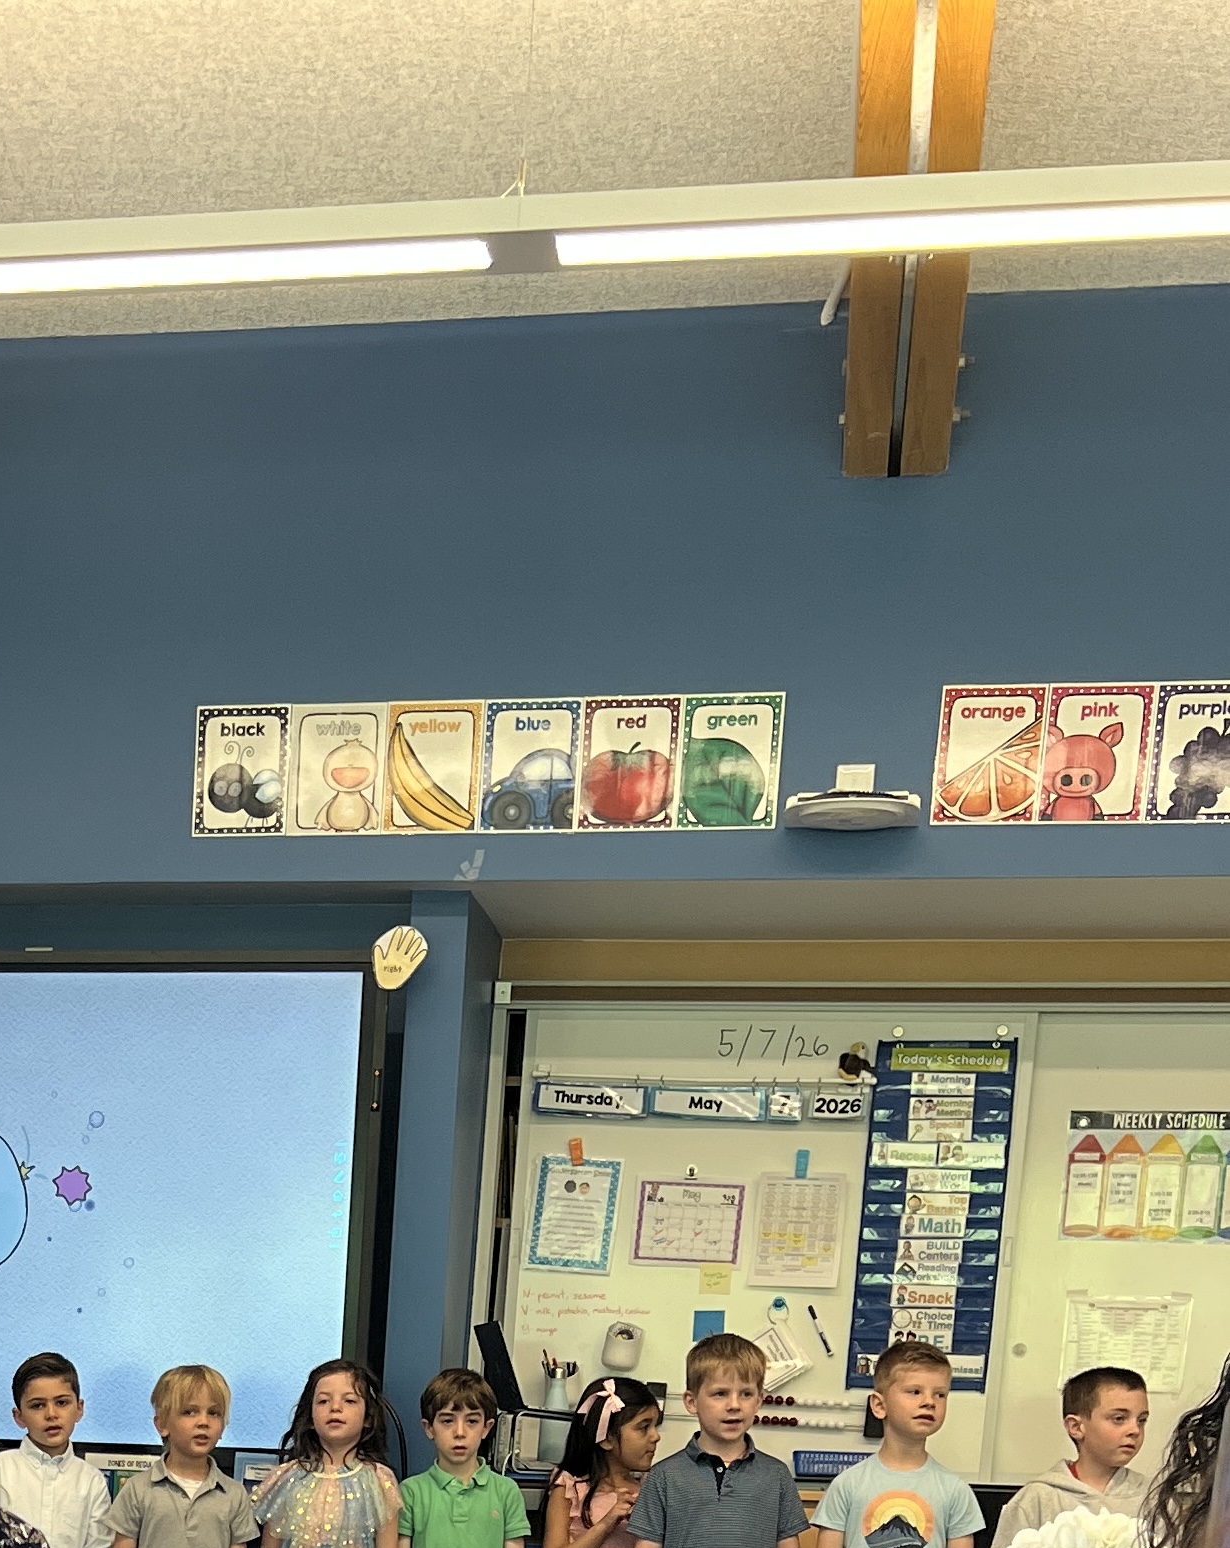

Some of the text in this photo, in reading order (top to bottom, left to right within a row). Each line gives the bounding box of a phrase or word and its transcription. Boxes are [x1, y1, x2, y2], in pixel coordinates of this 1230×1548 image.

[961, 704, 1026, 722] orange
[1080, 701, 1120, 721] pink
[220, 721, 265, 738] black
[316, 720, 362, 737] white
[409, 718, 462, 737] yellow
[515, 717, 551, 733] blue
[617, 714, 647, 731] red
[708, 714, 758, 730] green
[718, 1024, 830, 1067] 5/7/26
[897, 1053, 1004, 1067] Today's Schedule
[930, 1075, 971, 1086] Morning
[554, 1090, 624, 1109] Thursday
[688, 1096, 723, 1112] May
[815, 1098, 862, 1115] 2026
[936, 1099, 973, 1109] Morning
[936, 1108, 972, 1119] Meeting
[1112, 1112, 1227, 1130] WEEKLY SCHEDULE
[929, 1119, 965, 1131] Special
[890, 1150, 935, 1163] Recess
[940, 1171, 969, 1182] Word
[949, 1192, 968, 1206] Top
[917, 1216, 962, 1235] Math
[925, 1240, 961, 1251] BUILD
[917, 1251, 959, 1263] Centers
[916, 1262, 957, 1275] Reading
[907, 1289, 954, 1305] Snack
[916, 1311, 953, 1321] Choice
[927, 1321, 953, 1330] Time
